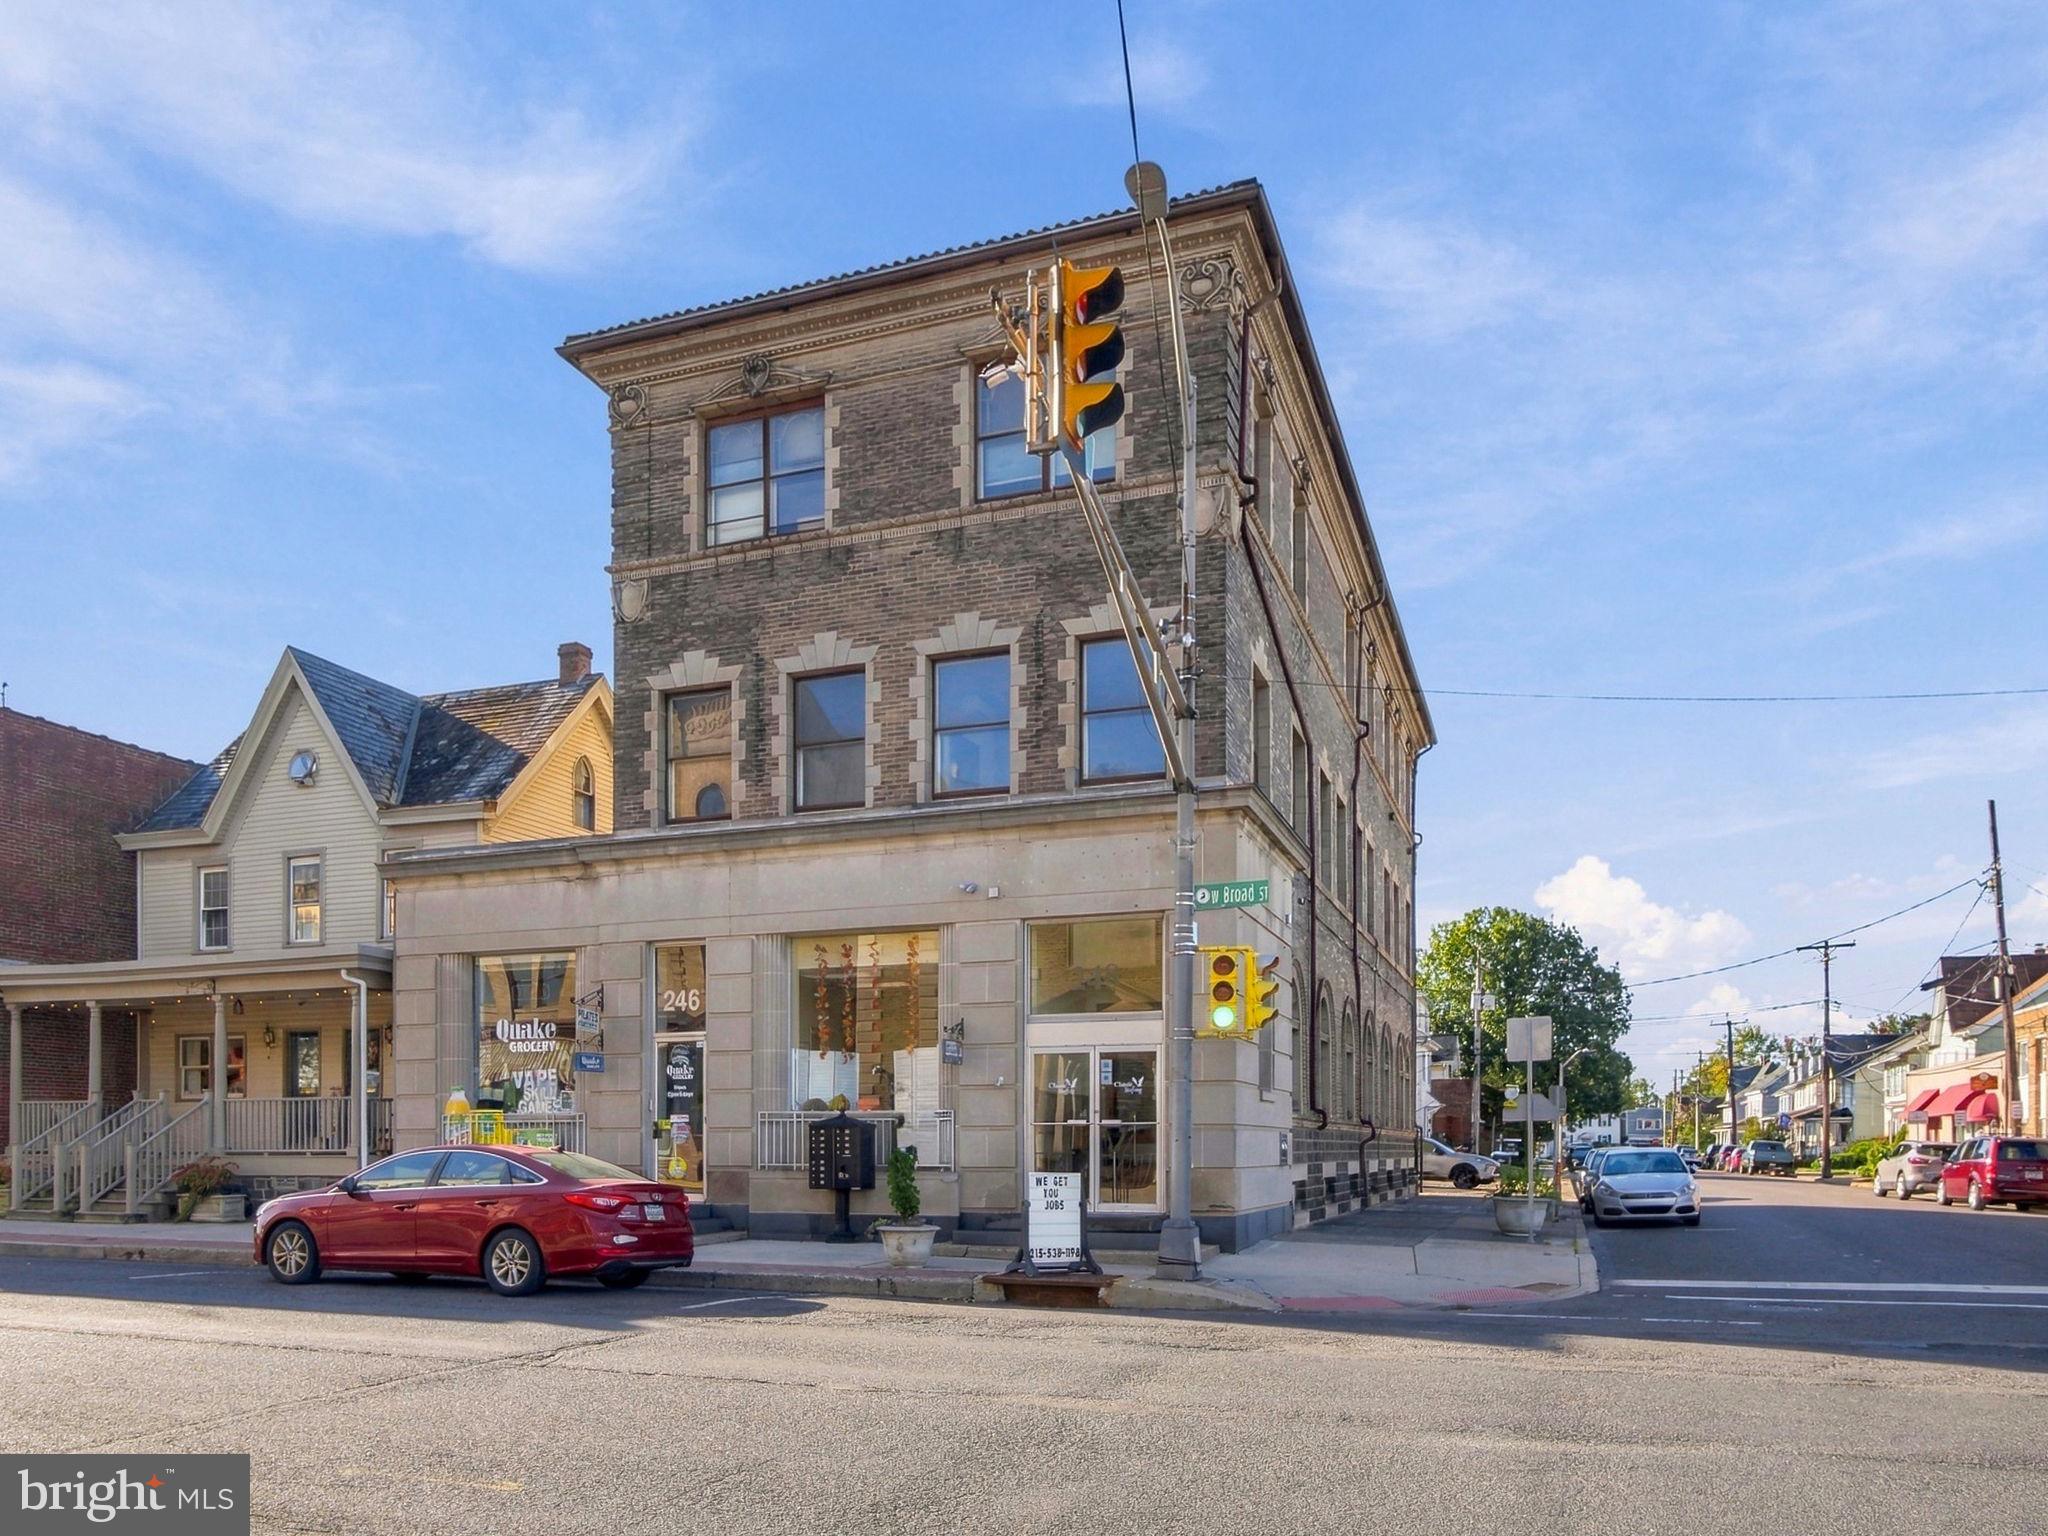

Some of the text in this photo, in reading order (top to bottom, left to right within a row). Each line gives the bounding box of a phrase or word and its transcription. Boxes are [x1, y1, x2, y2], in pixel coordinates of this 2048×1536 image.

[1223, 884, 1254, 903] Broad
[663, 989, 700, 1012] 246
[496, 1017, 557, 1042] Quake
[509, 1041, 556, 1053] GROCERY
[667, 1064, 694, 1076] Quake
[512, 1068, 557, 1089] VAPE
[523, 1085, 557, 1101] SKILL
[1035, 1176, 1068, 1187] WE GET
[1043, 1188, 1059, 1198] YOU
[1044, 1200, 1065, 1210] JOBS
